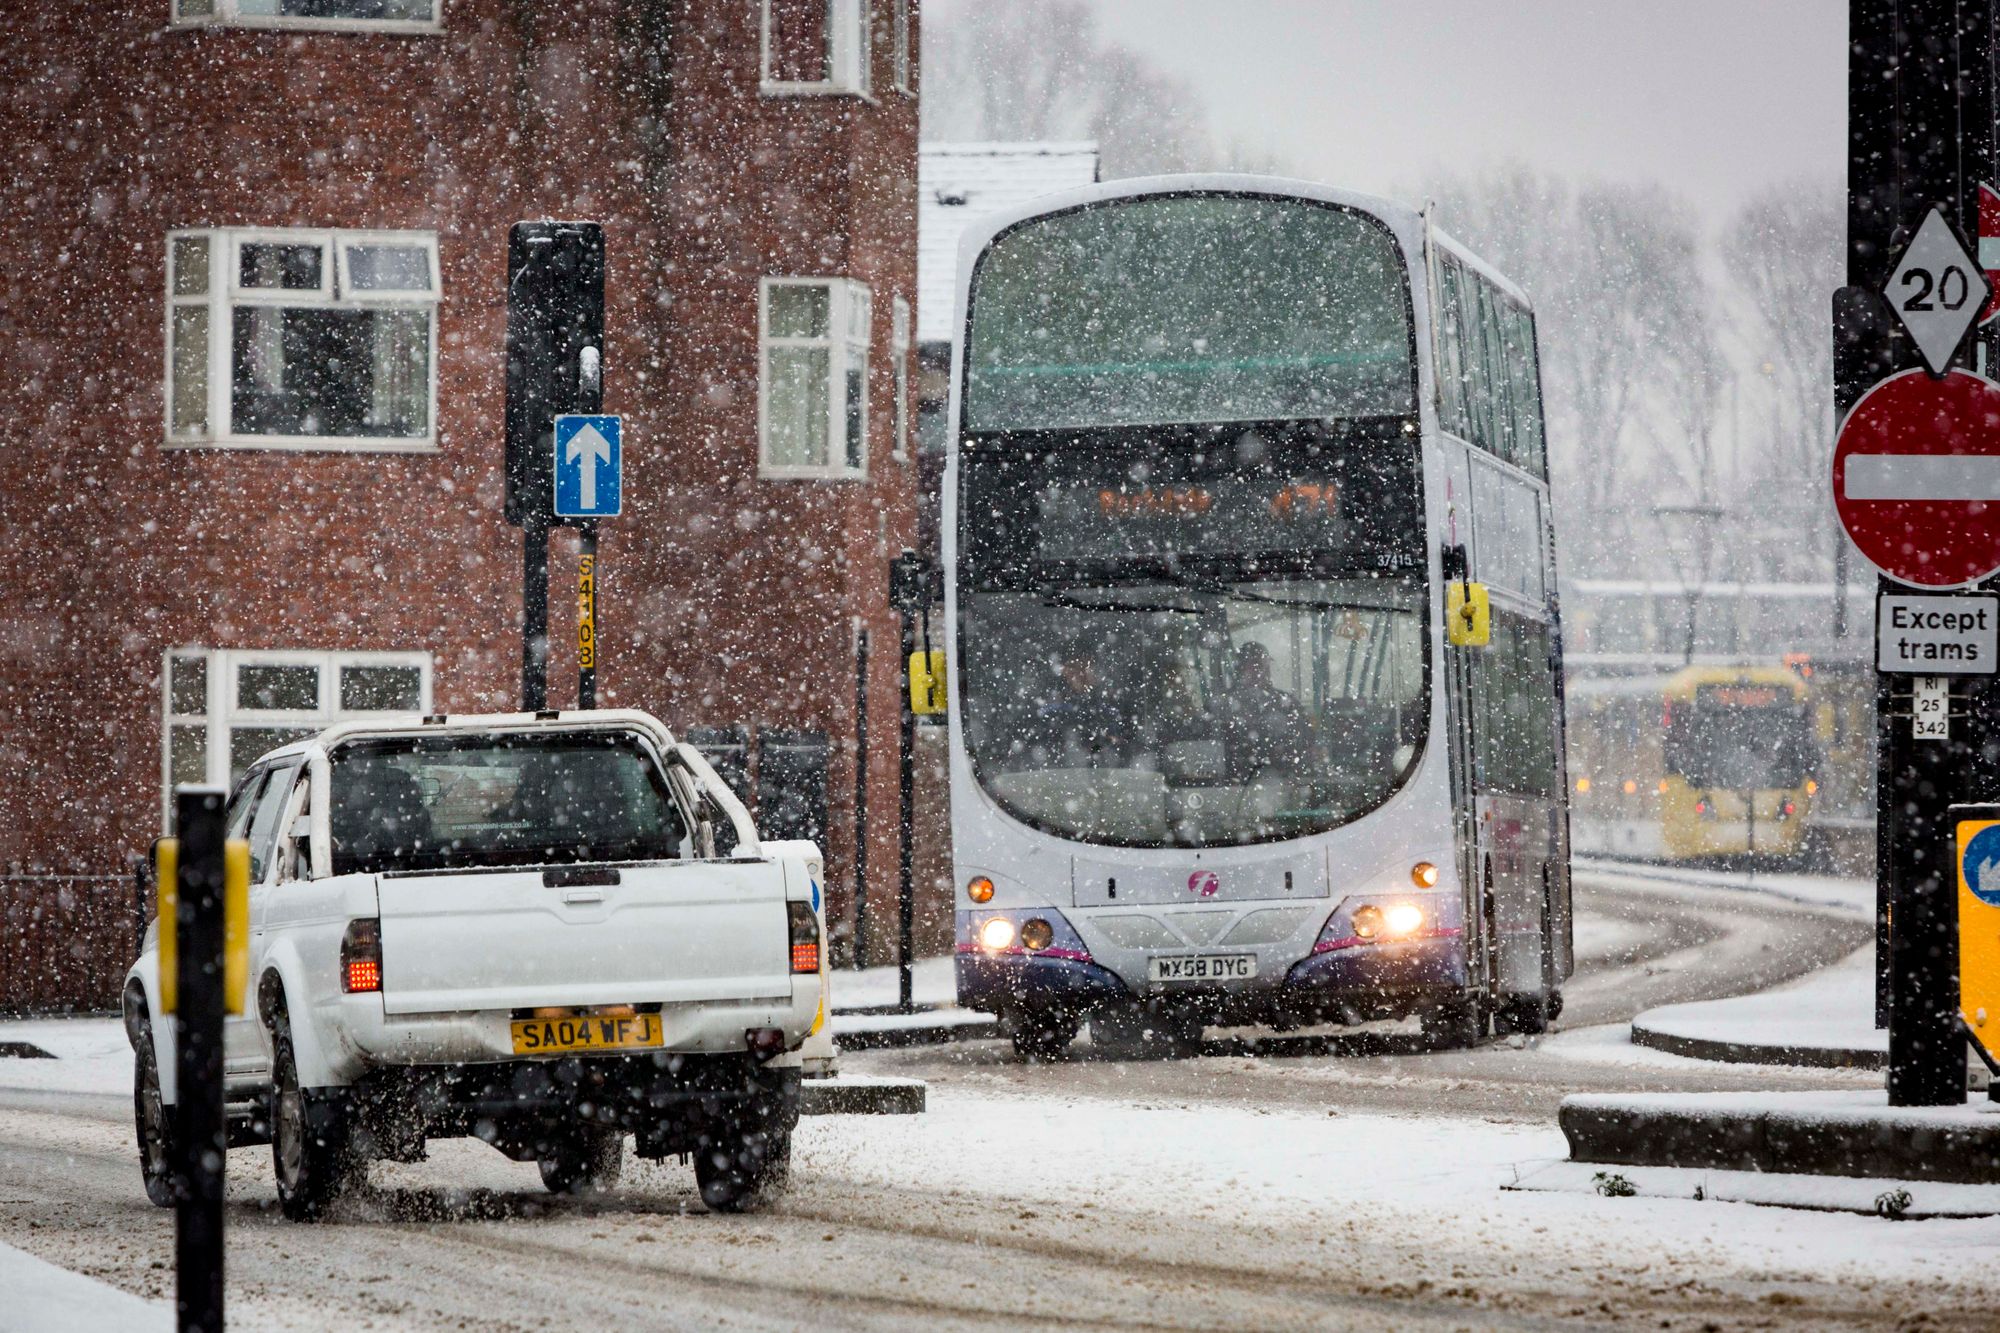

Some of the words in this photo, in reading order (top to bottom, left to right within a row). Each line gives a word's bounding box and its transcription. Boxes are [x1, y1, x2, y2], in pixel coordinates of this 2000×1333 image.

[1901, 265, 1968, 311] 20
[1377, 553, 1413, 567] 37415
[1892, 606, 1987, 634] Except
[1898, 637, 1978, 660] trams
[1921, 699, 1940, 712] 25
[1916, 721, 1946, 734] 342
[1159, 960, 1207, 977] MX58
[1212, 958, 1248, 976] DYG
[522, 1020, 592, 1048] SA04
[600, 1018, 651, 1043] WFJ
